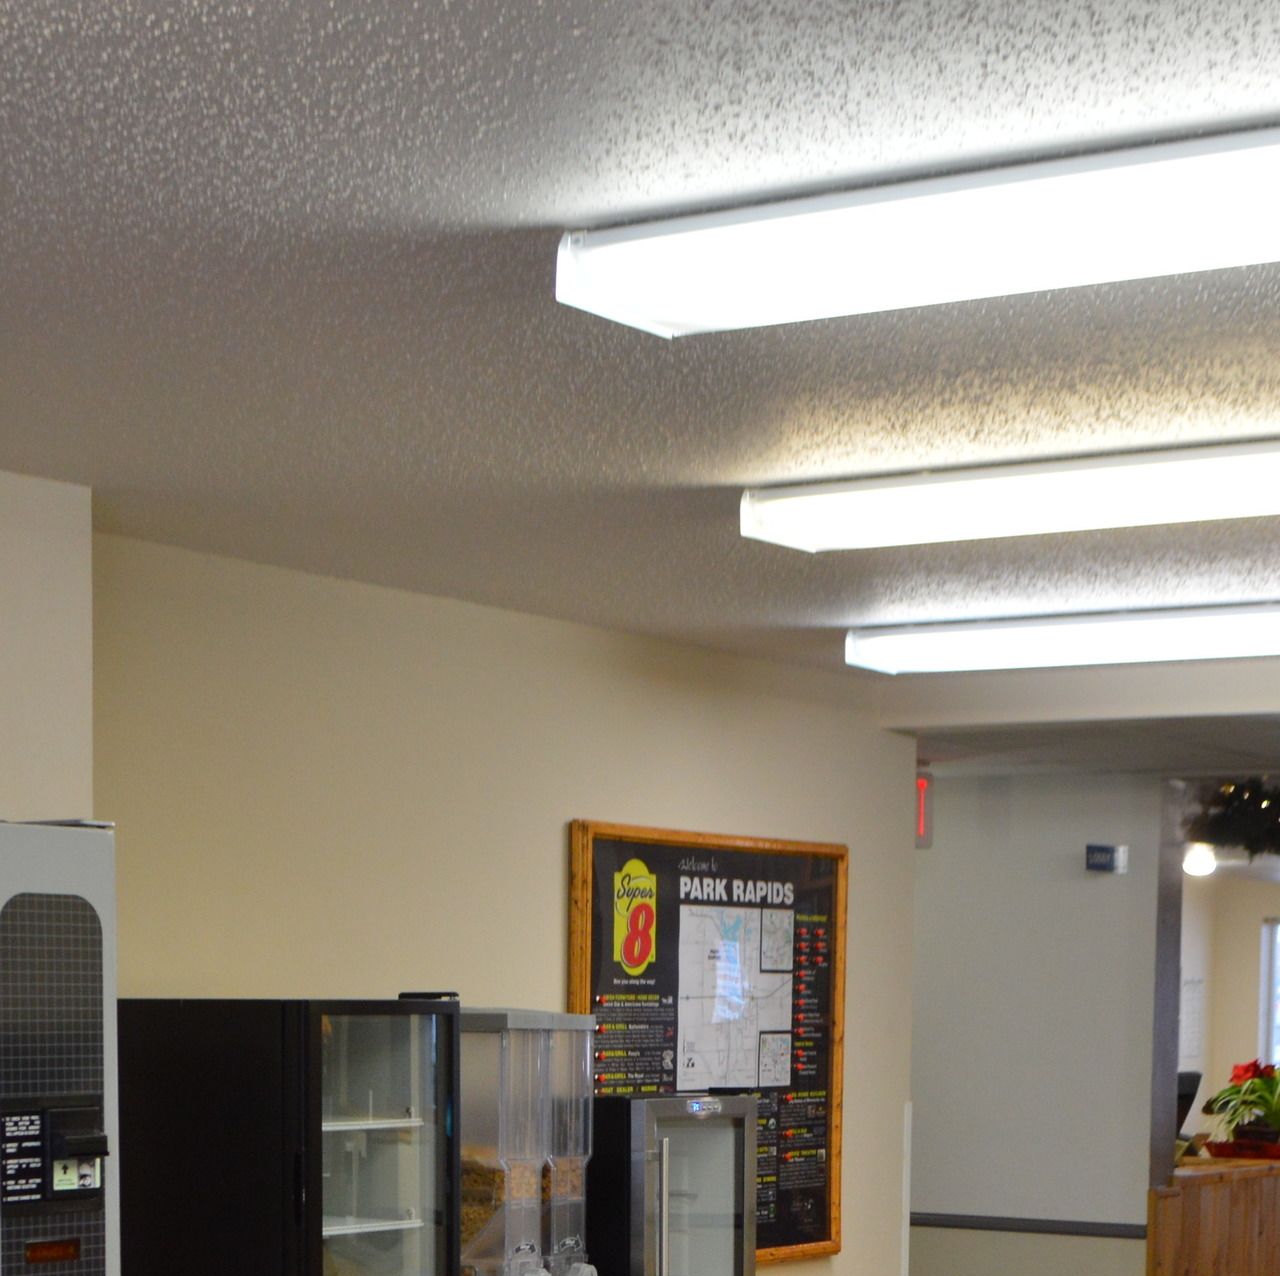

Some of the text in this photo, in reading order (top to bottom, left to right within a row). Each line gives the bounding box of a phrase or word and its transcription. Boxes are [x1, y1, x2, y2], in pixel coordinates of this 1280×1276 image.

[616, 874, 655, 912] Super
[680, 876, 795, 904] PARK RAPIDS
[622, 903, 655, 968] 8
